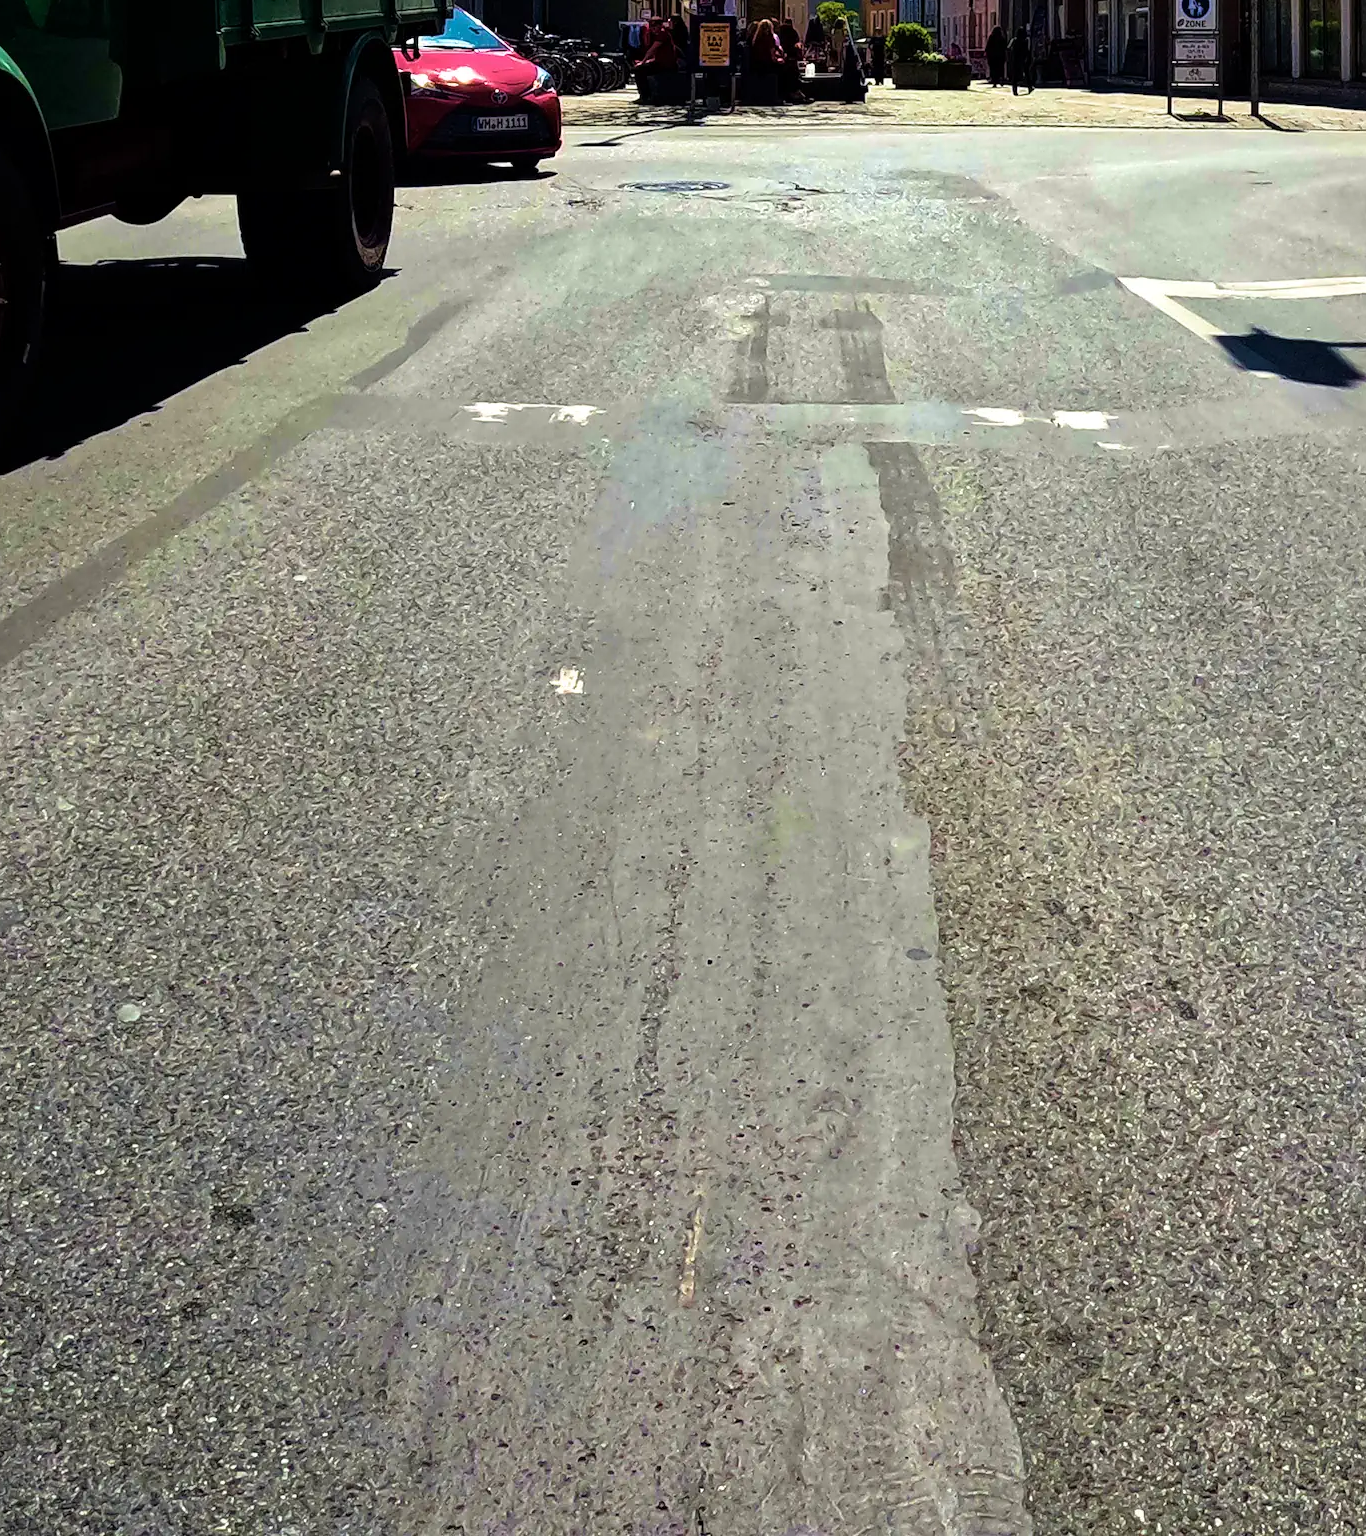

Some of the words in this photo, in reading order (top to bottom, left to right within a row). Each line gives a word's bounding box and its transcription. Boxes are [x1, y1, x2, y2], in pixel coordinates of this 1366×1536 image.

[1185, 20, 1207, 28] ZONE
[478, 119, 490, 129] WM
[497, 118, 503, 129] H
[505, 117, 527, 128] 1111
